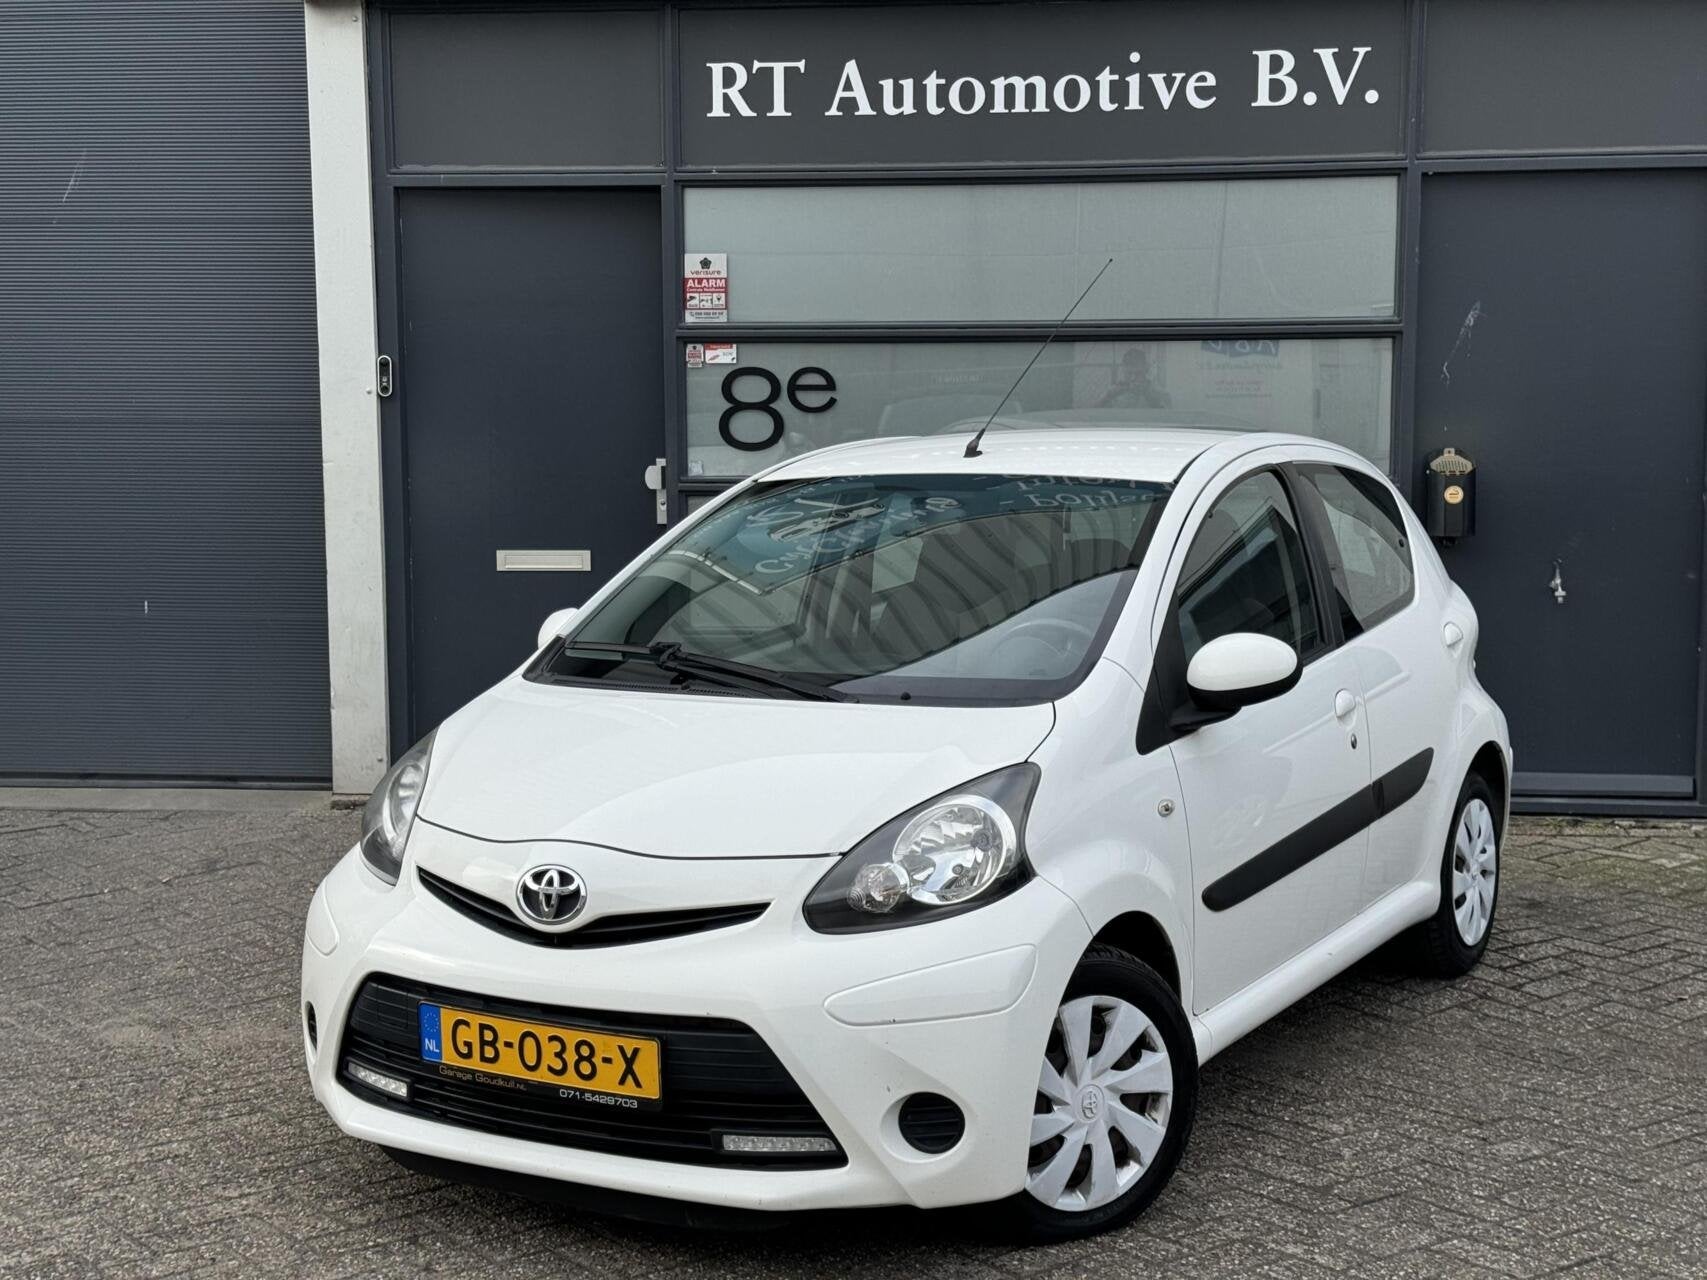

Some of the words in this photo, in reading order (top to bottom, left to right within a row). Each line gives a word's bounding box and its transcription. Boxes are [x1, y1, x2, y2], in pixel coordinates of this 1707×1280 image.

[706, 58, 806, 118] RT
[824, 51, 1218, 117] Automotive
[1251, 45, 1381, 108] B.V.
[687, 279, 726, 288] ALARM
[718, 366, 838, 453] 8e
[424, 1037, 440, 1053] NL
[451, 1018, 644, 1089] GB-038-X
[438, 1065, 473, 1082] Garage
